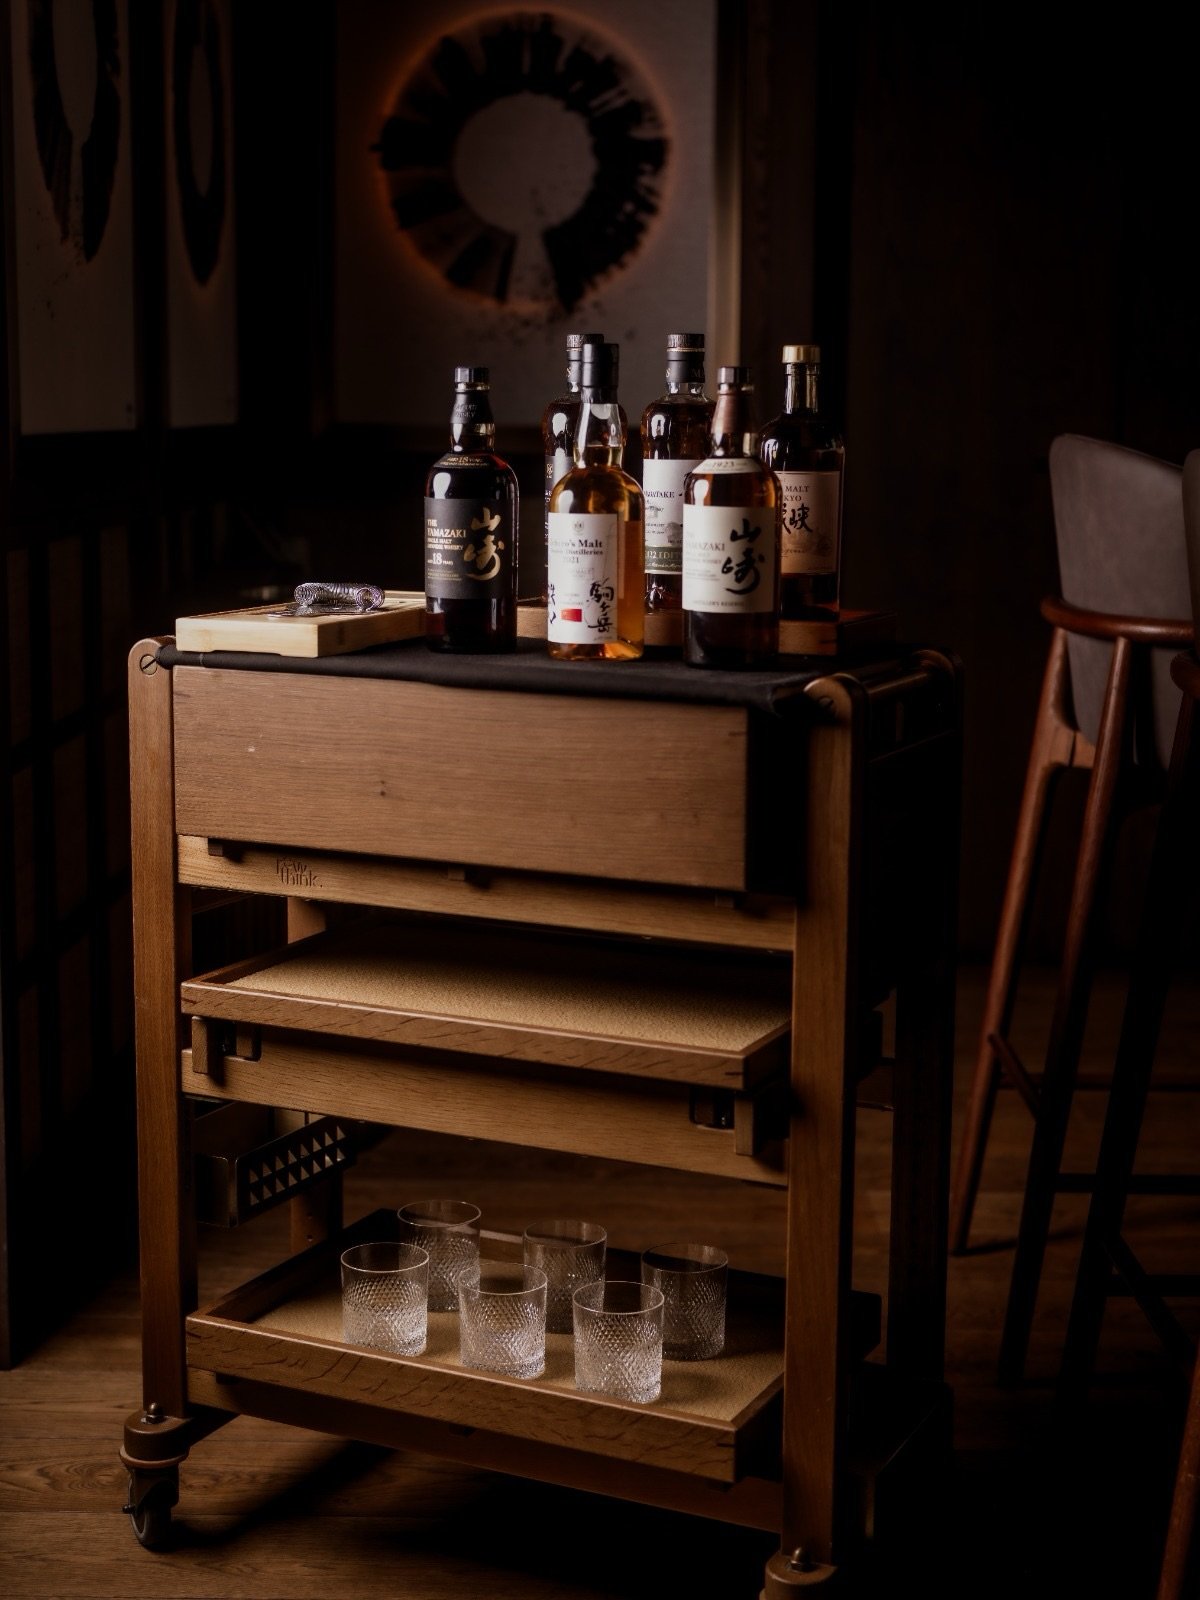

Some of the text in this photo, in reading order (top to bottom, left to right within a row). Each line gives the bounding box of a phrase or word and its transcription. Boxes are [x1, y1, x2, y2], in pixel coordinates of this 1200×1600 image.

[785, 485, 810, 493] MALT
[578, 539, 603, 548] Malt
[432, 552, 443, 565] 18
[721, 518, 765, 596] 山崎
